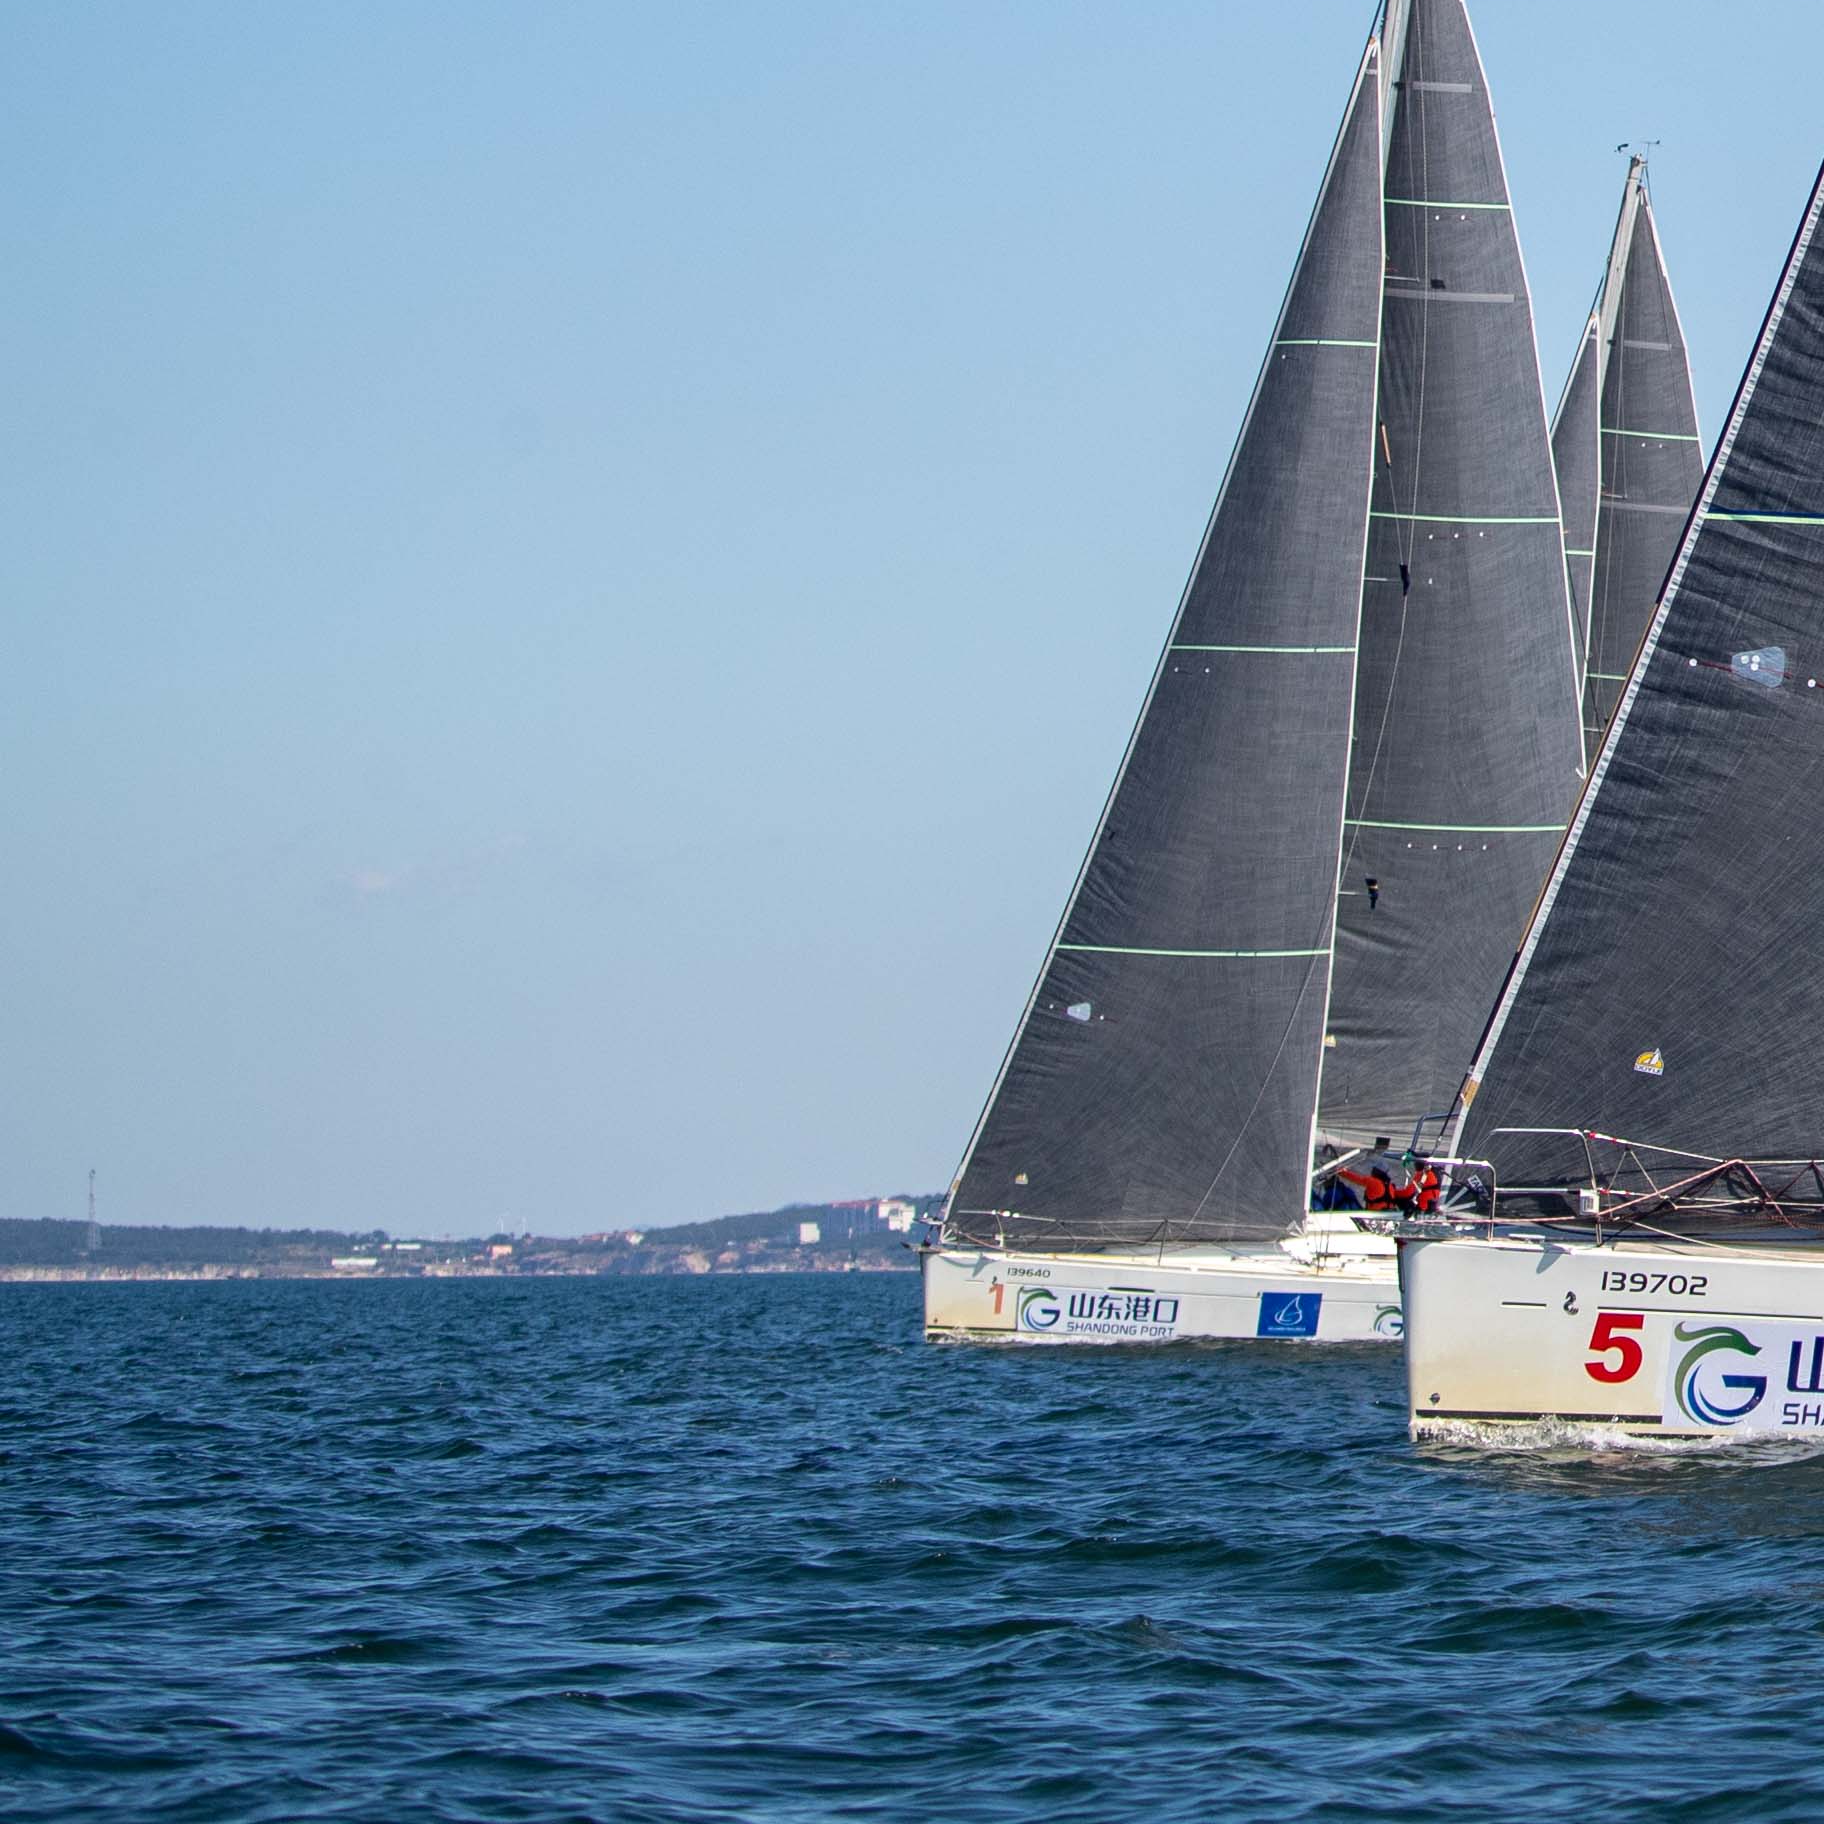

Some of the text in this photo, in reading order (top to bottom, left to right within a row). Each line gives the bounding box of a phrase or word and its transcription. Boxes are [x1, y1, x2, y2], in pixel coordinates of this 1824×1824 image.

[1007, 1267, 1051, 1279] 139640
[1602, 1271, 1708, 1297] 139702
[989, 1283, 1004, 1314] 1
[1069, 1293, 1179, 1323] 山东港口
[1067, 1321, 1175, 1337] SHANDONG PORT
[1585, 1313, 1644, 1384] 5
